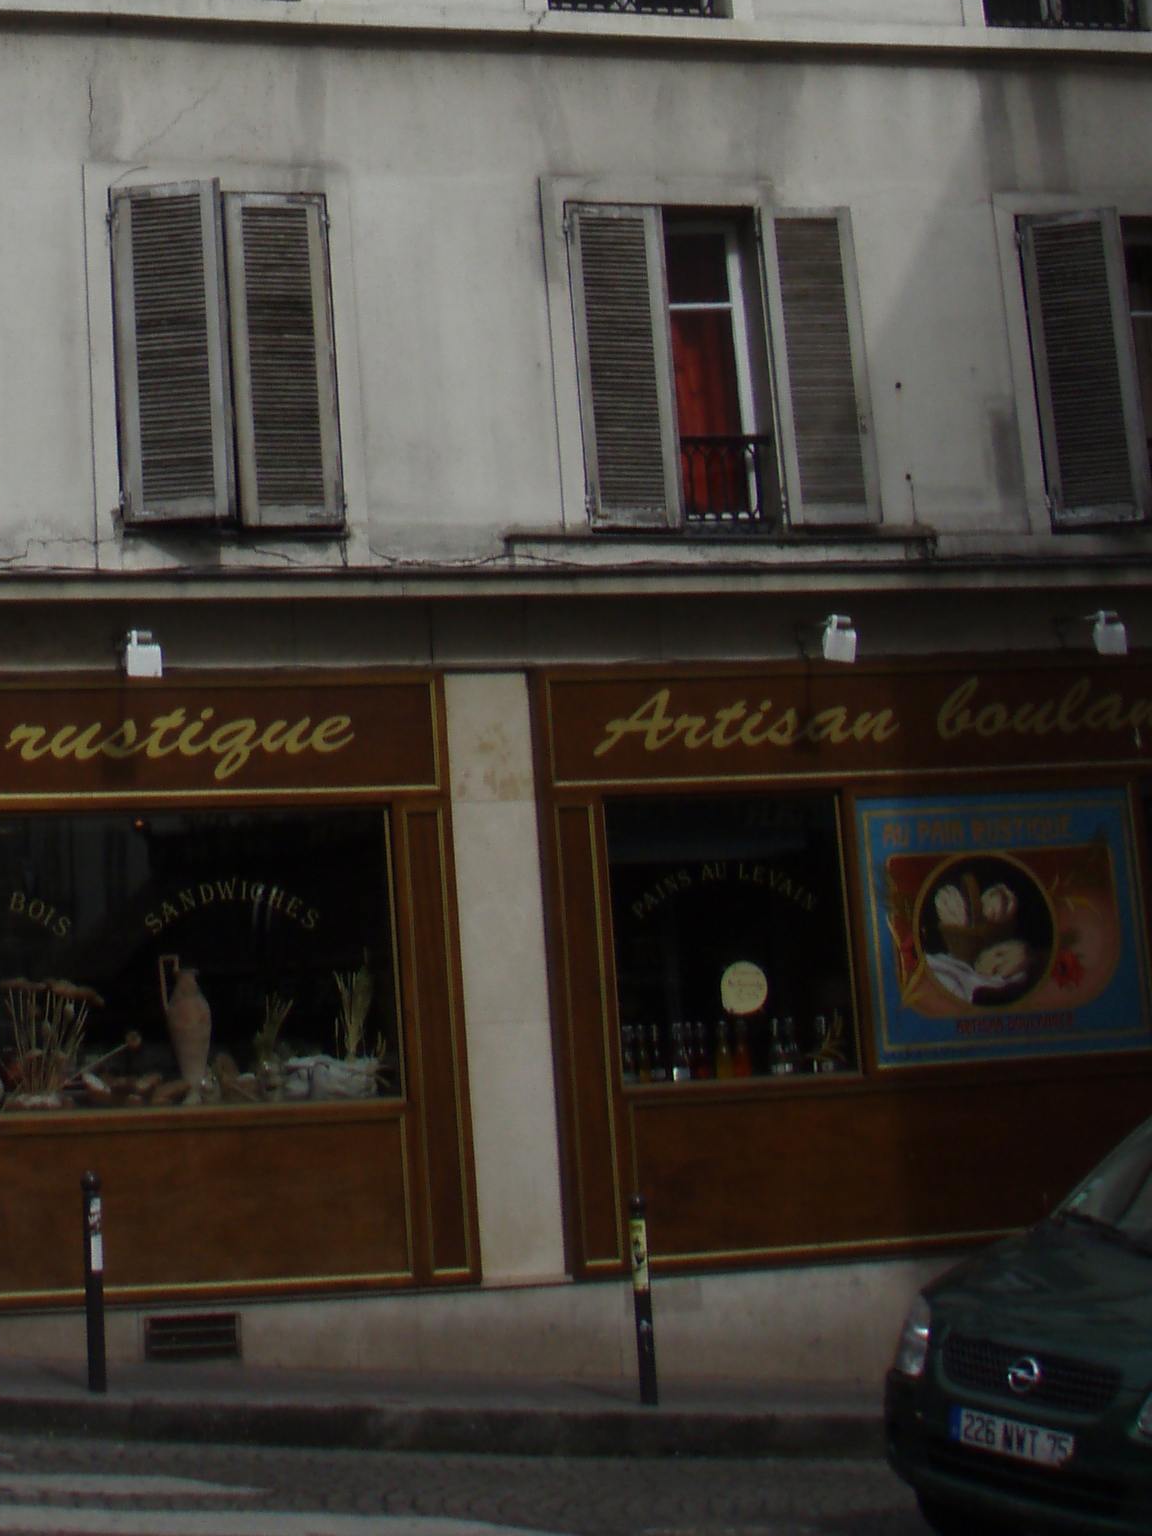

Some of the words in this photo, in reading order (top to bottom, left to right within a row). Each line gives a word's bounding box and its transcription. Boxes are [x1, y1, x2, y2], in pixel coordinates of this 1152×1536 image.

[5, 705, 357, 782] rustique
[592, 687, 900, 758] Artisan
[882, 823, 909, 847] AU
[917, 820, 965, 845] PAIN
[971, 815, 1073, 844] RUSTIQUE
[9, 891, 74, 939] BOIS
[144, 875, 320, 936] SANDWICHES
[631, 869, 692, 919] PAINS
[702, 863, 727, 882] AU
[738, 863, 818, 911] LEVAIN
[963, 1414, 996, 1445] 226
[1047, 1433, 1070, 1462] 75
